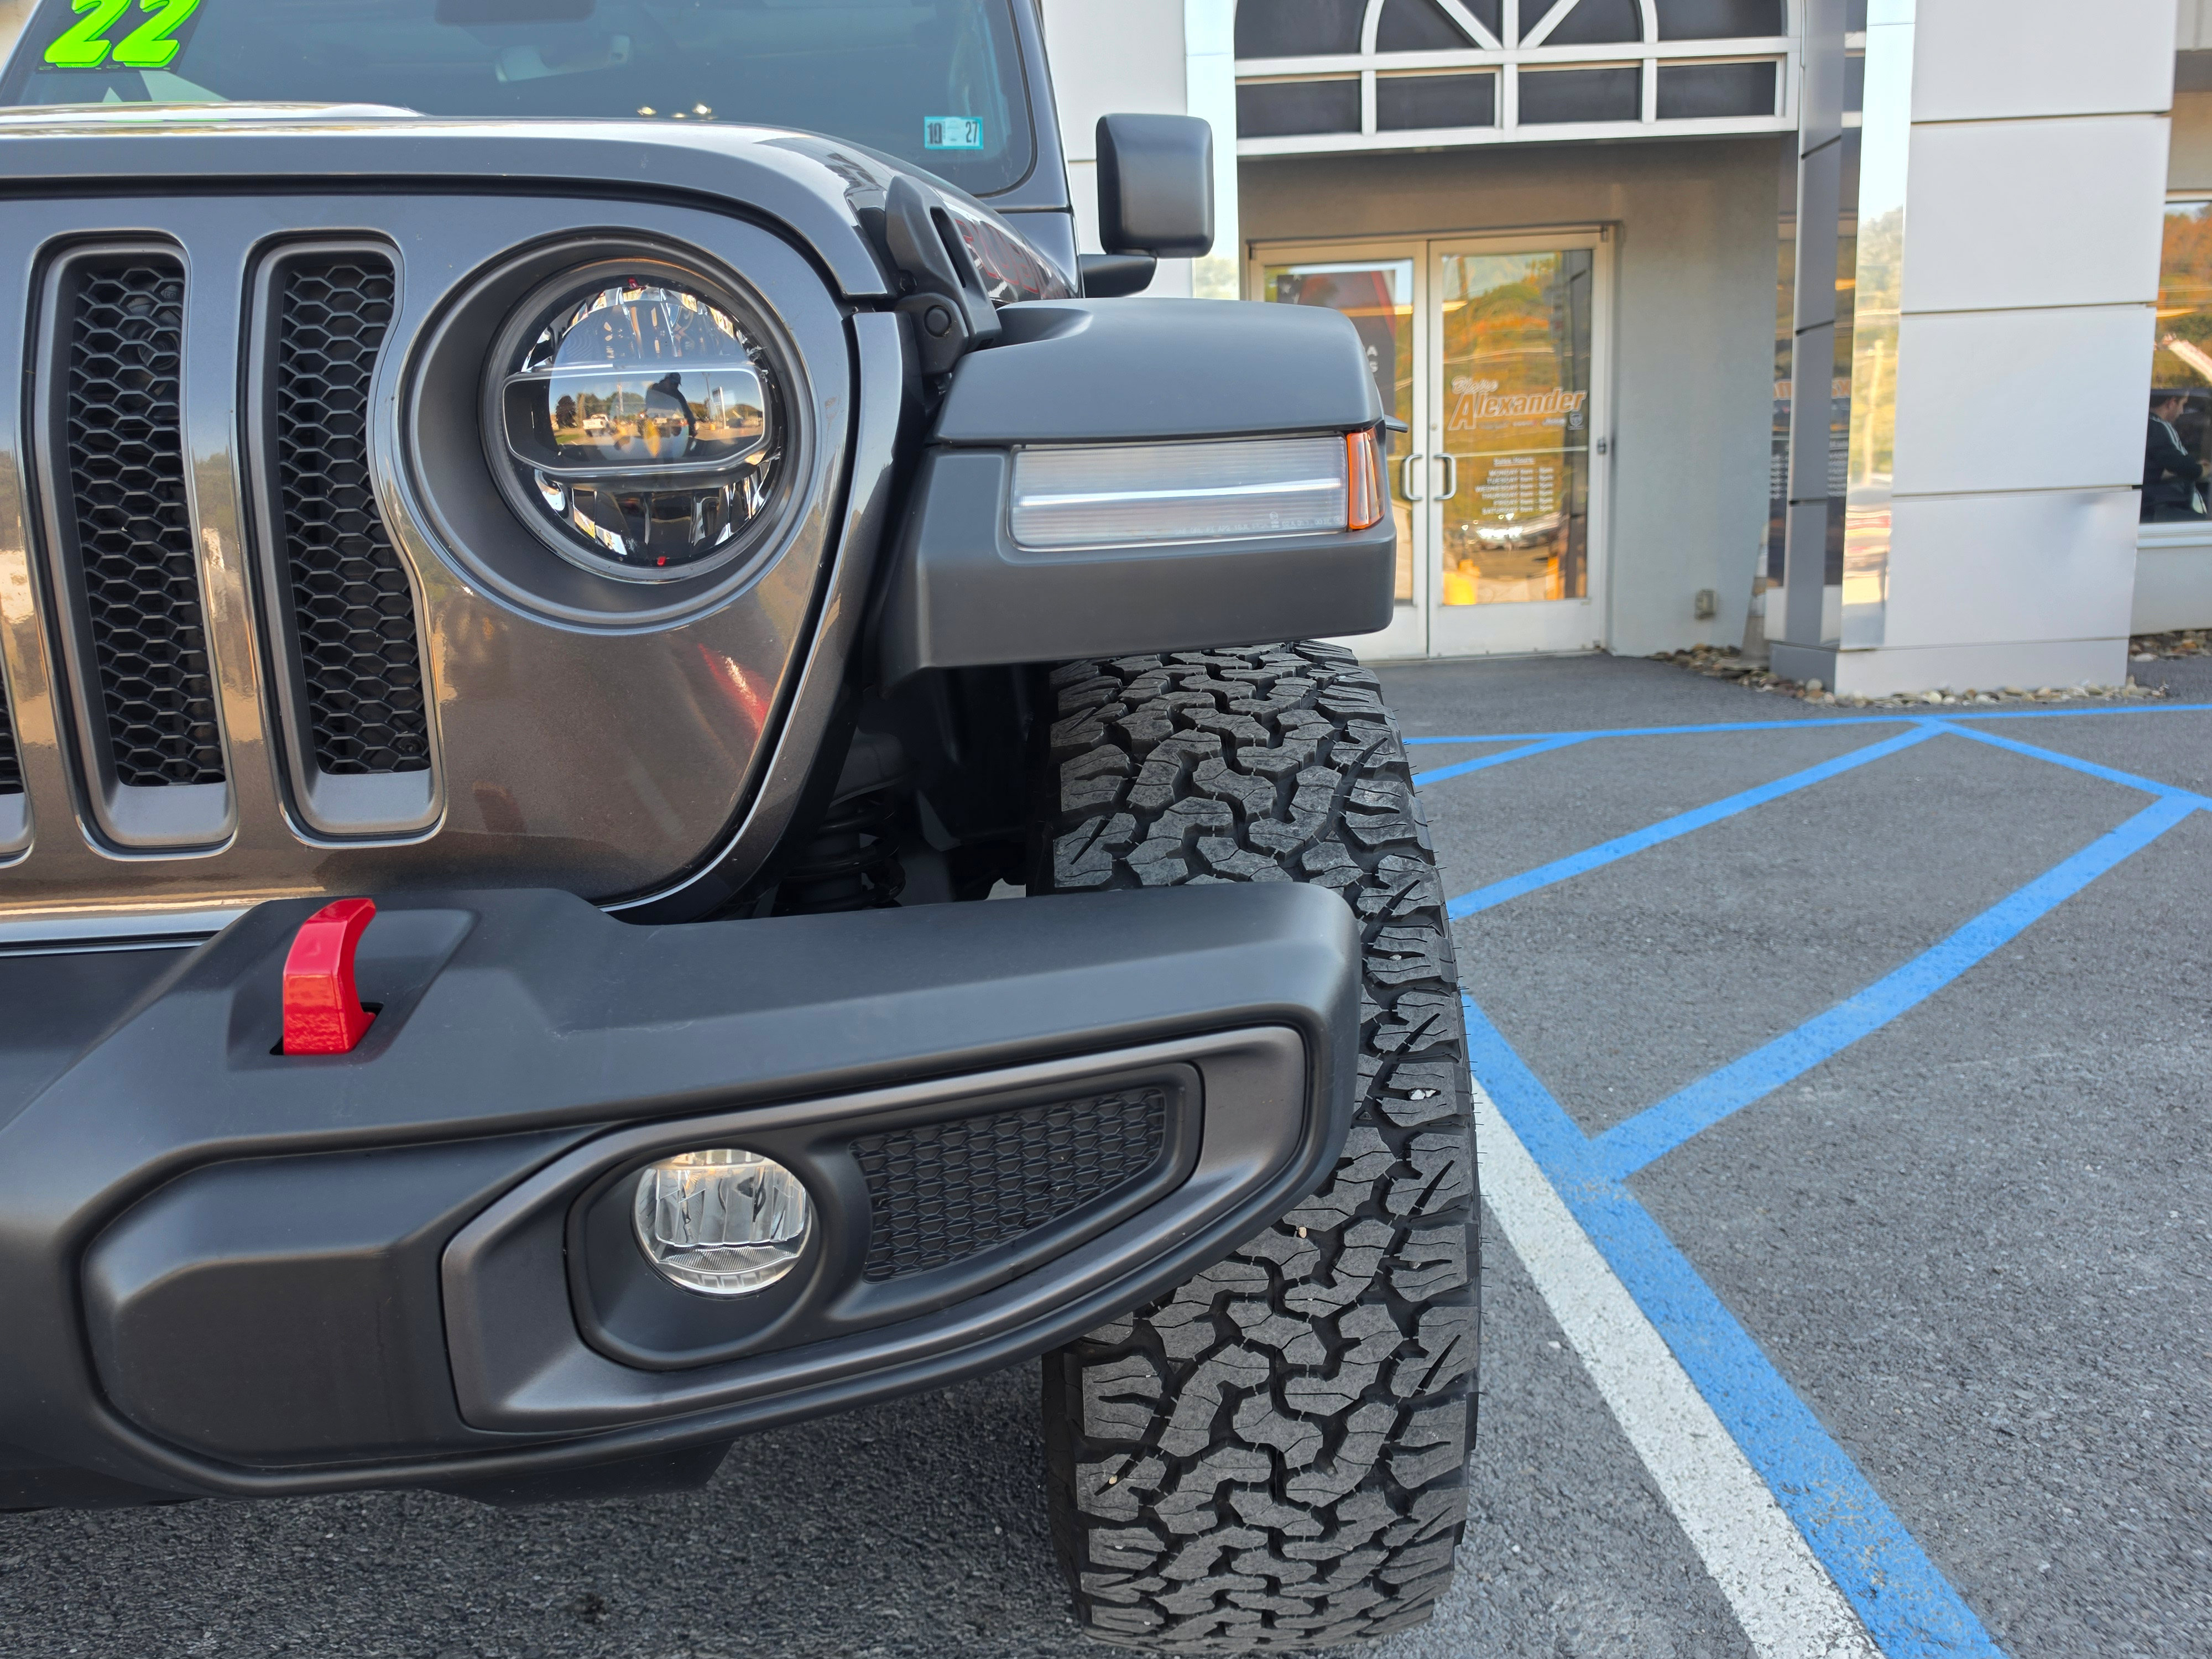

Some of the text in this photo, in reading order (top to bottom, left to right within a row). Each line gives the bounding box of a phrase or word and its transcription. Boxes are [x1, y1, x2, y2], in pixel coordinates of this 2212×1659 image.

[44, 0, 200, 67] 22
[966, 121, 978, 143] 27
[1448, 387, 1588, 430] Alexander
